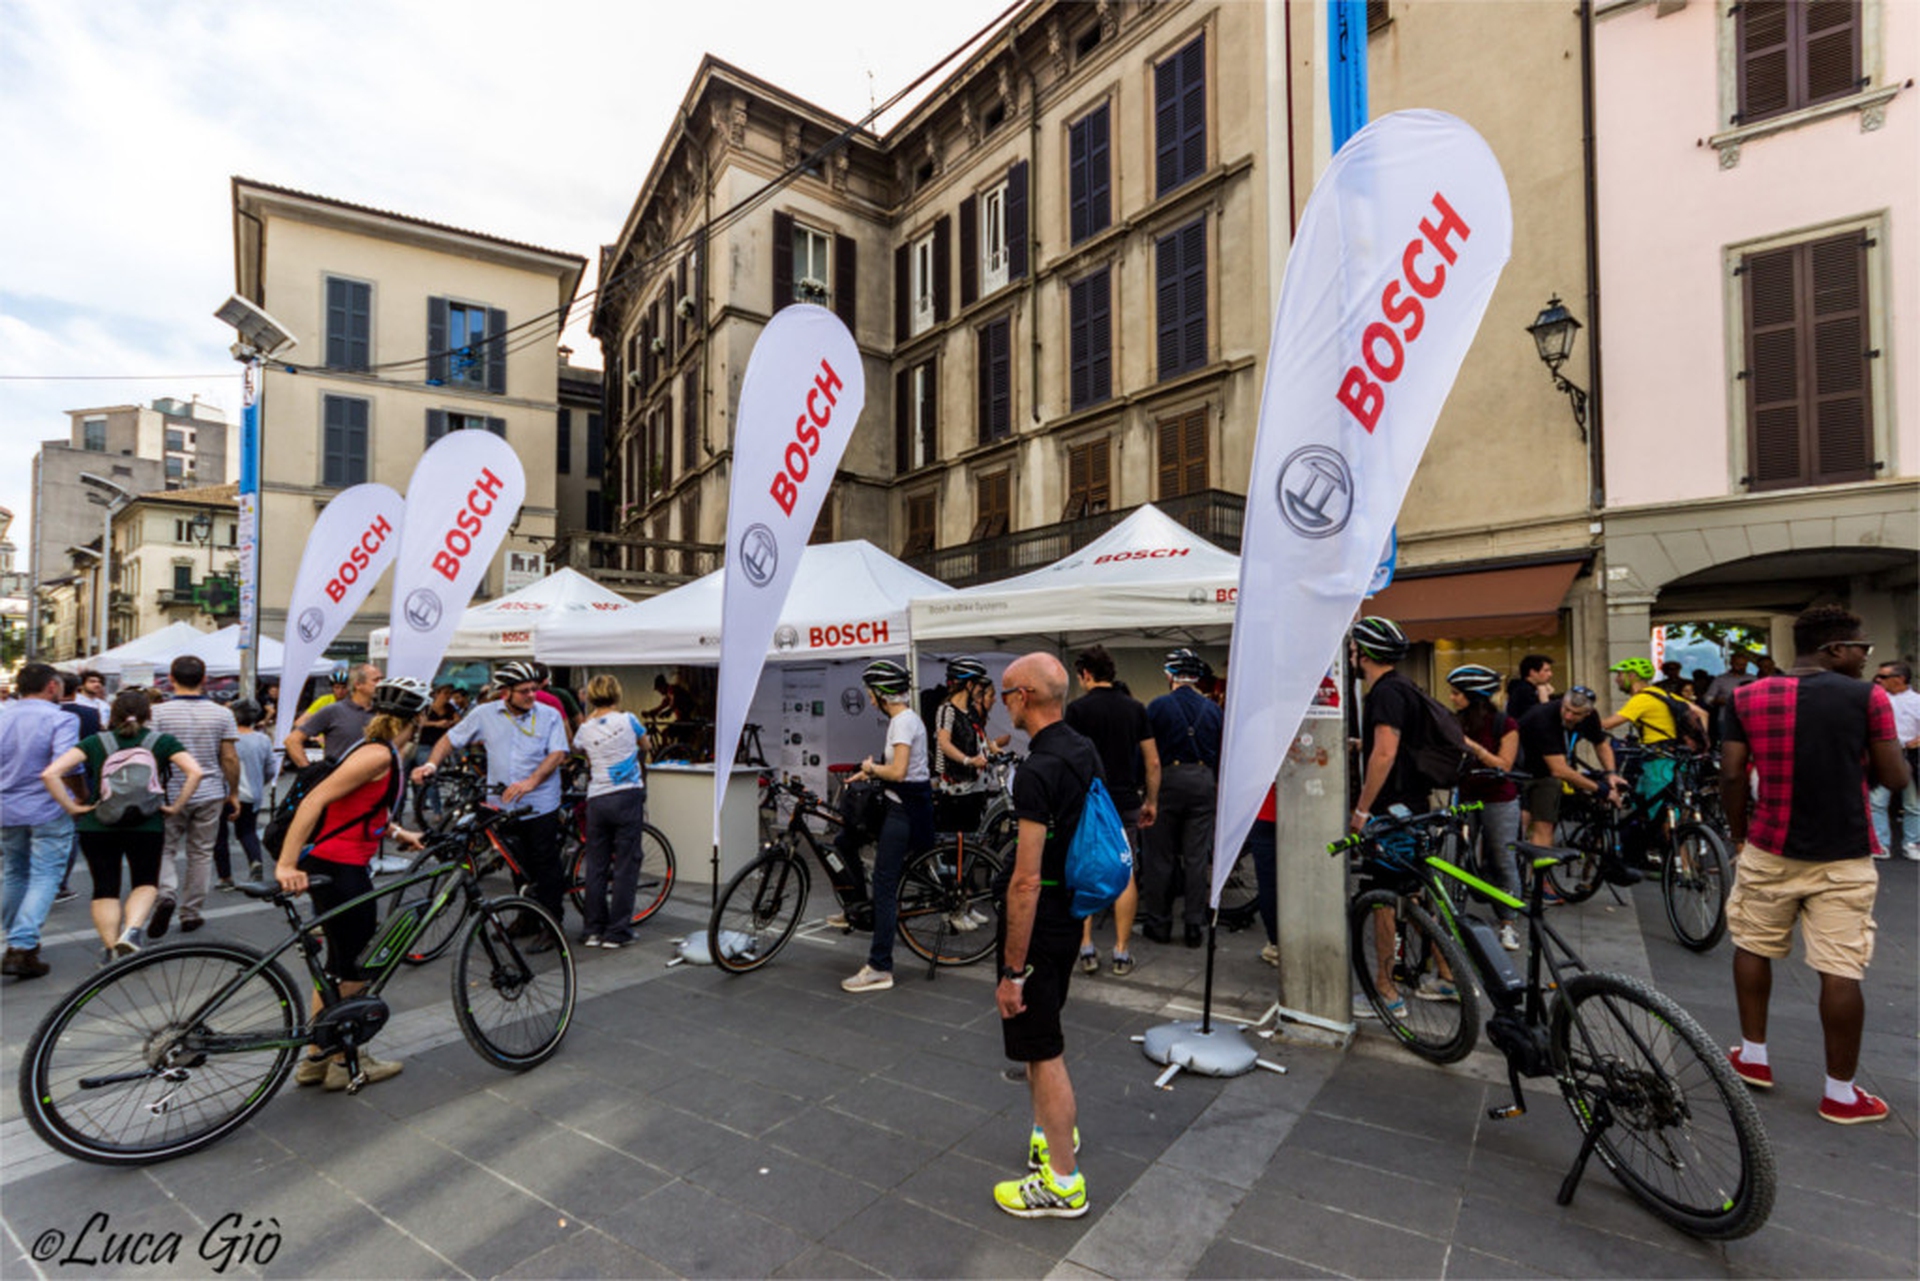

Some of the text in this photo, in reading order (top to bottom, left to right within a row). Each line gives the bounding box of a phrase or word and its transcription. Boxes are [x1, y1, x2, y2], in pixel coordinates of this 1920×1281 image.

[1336, 191, 1471, 435] BOSCH
[769, 359, 844, 517] BOSCH
[324, 514, 392, 604] BOSCH
[431, 467, 504, 582] BOSCH
[1093, 548, 1191, 565] BOSCH
[502, 631, 530, 643] BOSCH
[809, 620, 890, 648] BOSCH
